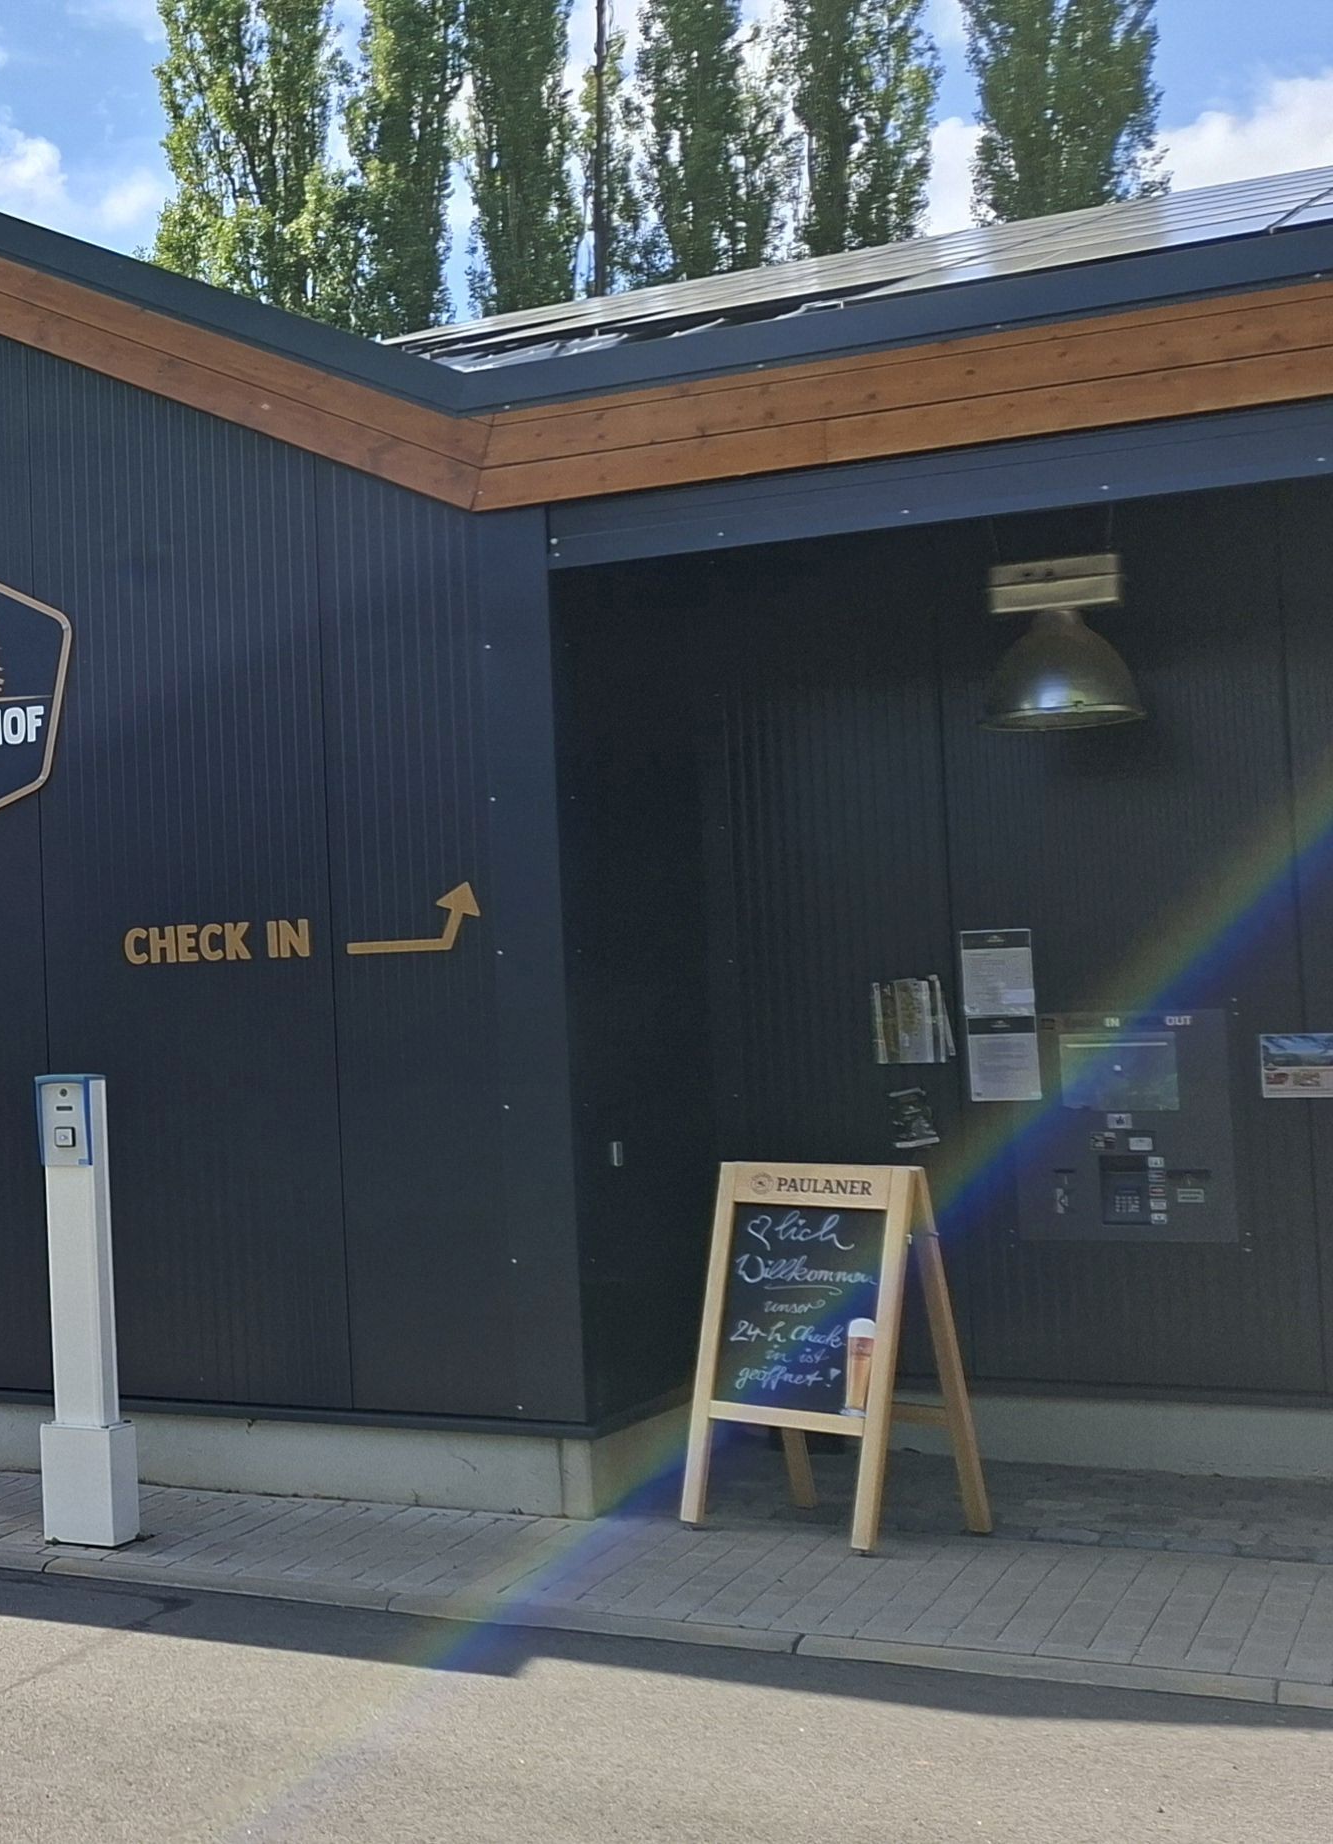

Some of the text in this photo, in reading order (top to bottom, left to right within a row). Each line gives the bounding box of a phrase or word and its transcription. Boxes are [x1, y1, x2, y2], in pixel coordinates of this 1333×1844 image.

[123, 918, 310, 965] CHECK IN
[1104, 1017, 1121, 1028] IN
[1165, 1015, 1193, 1027] OUT
[776, 1176, 873, 1196] PAULANER
